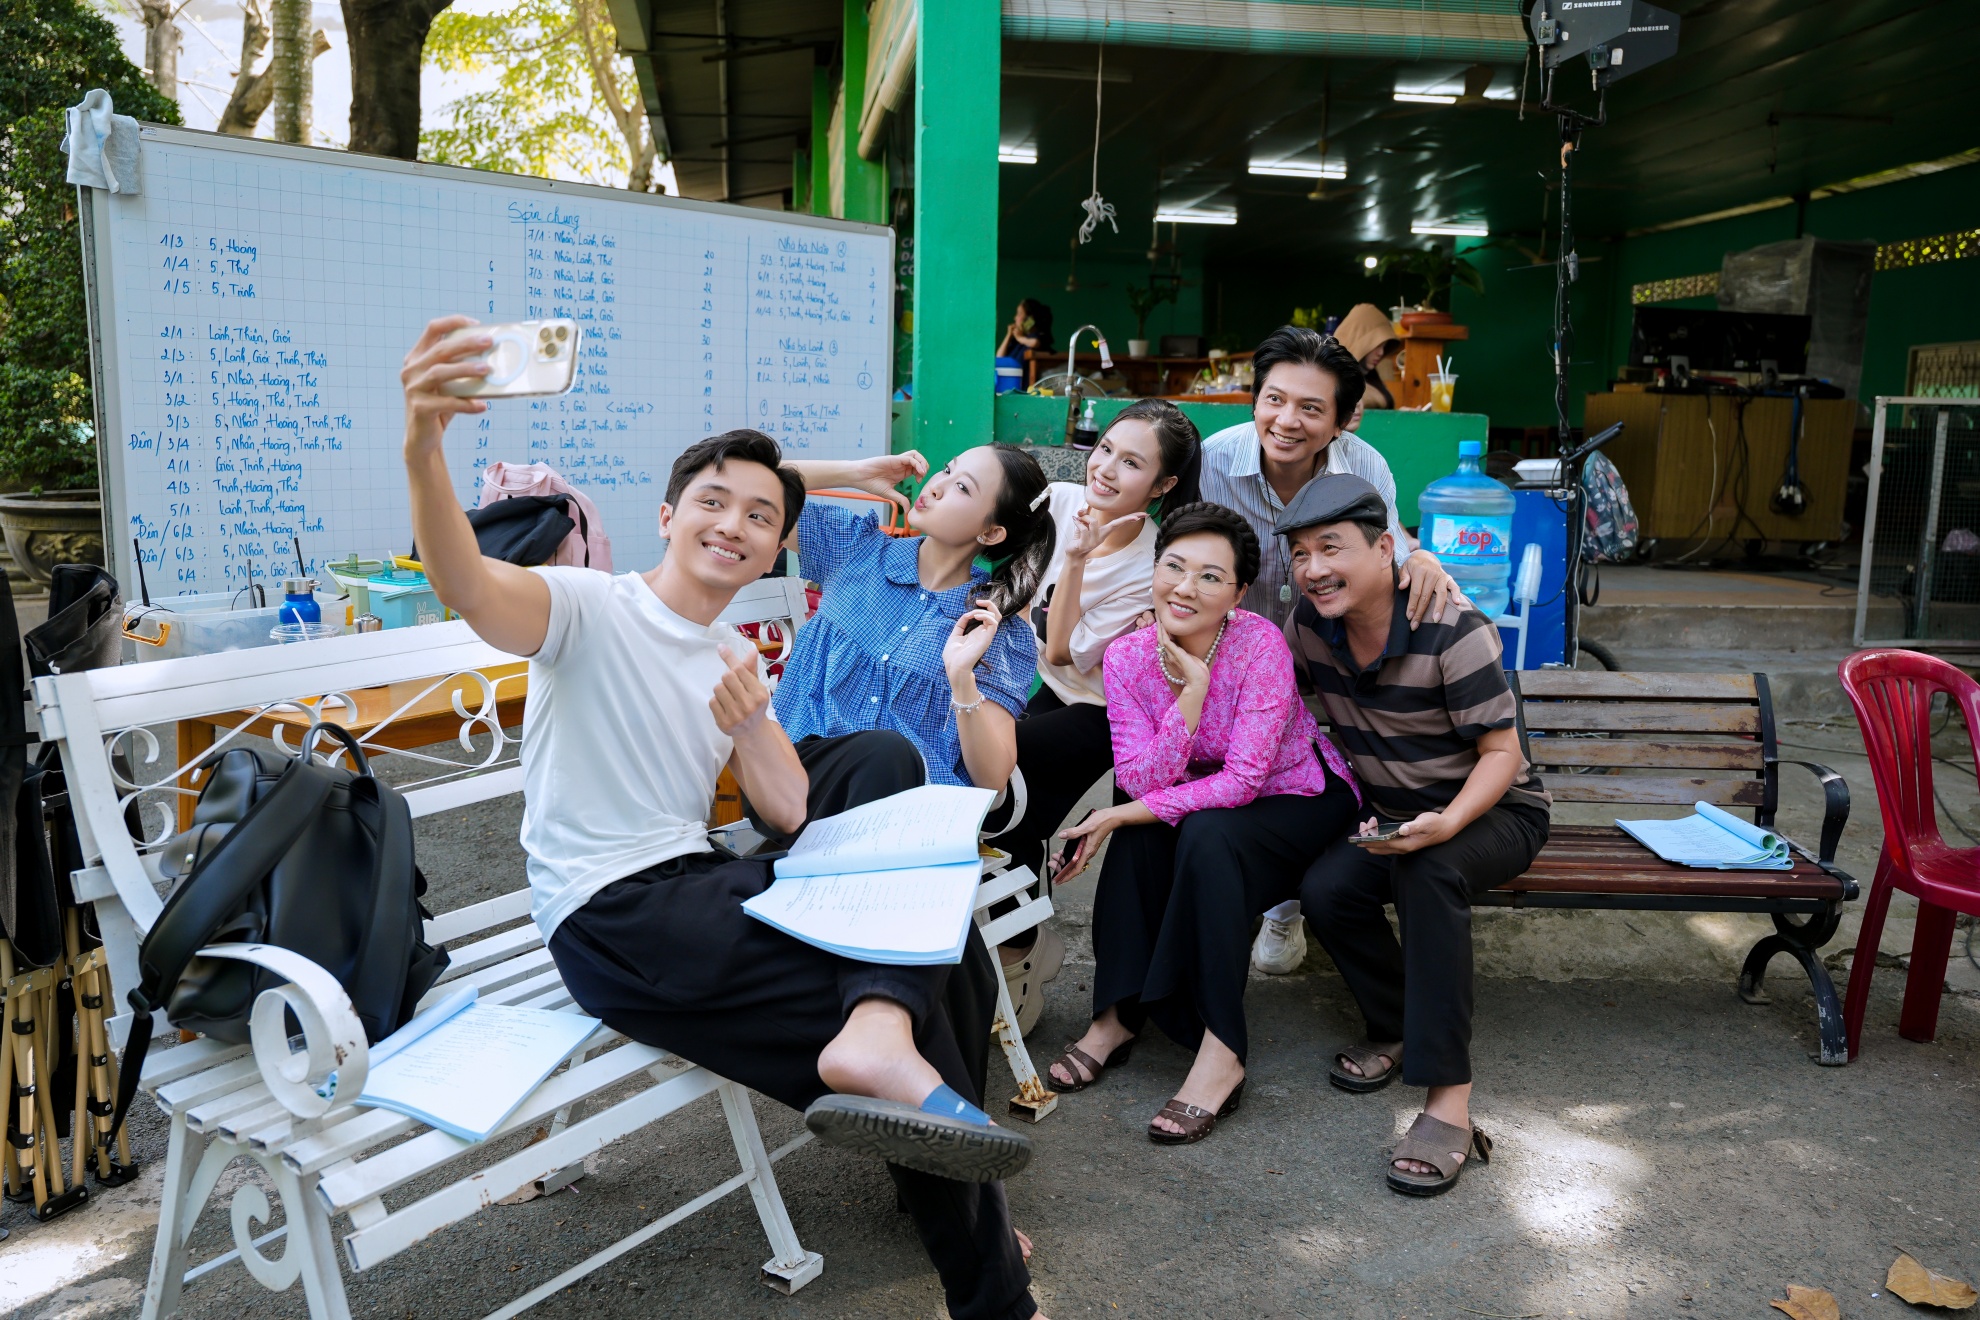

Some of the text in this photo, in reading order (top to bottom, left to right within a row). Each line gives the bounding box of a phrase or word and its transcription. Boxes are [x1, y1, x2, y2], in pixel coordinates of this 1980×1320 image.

[1574, 0, 1622, 8] SENNHEISER
[508, 201, 579, 234] Sân chung
[226, 240, 256, 263] Hoàng
[489, 261, 493, 272] 6
[488, 280, 493, 291] 7
[489, 300, 493, 313] 8
[478, 419, 489, 430] 11
[473, 458, 487, 467] 24
[1458, 530, 1492, 551] top
